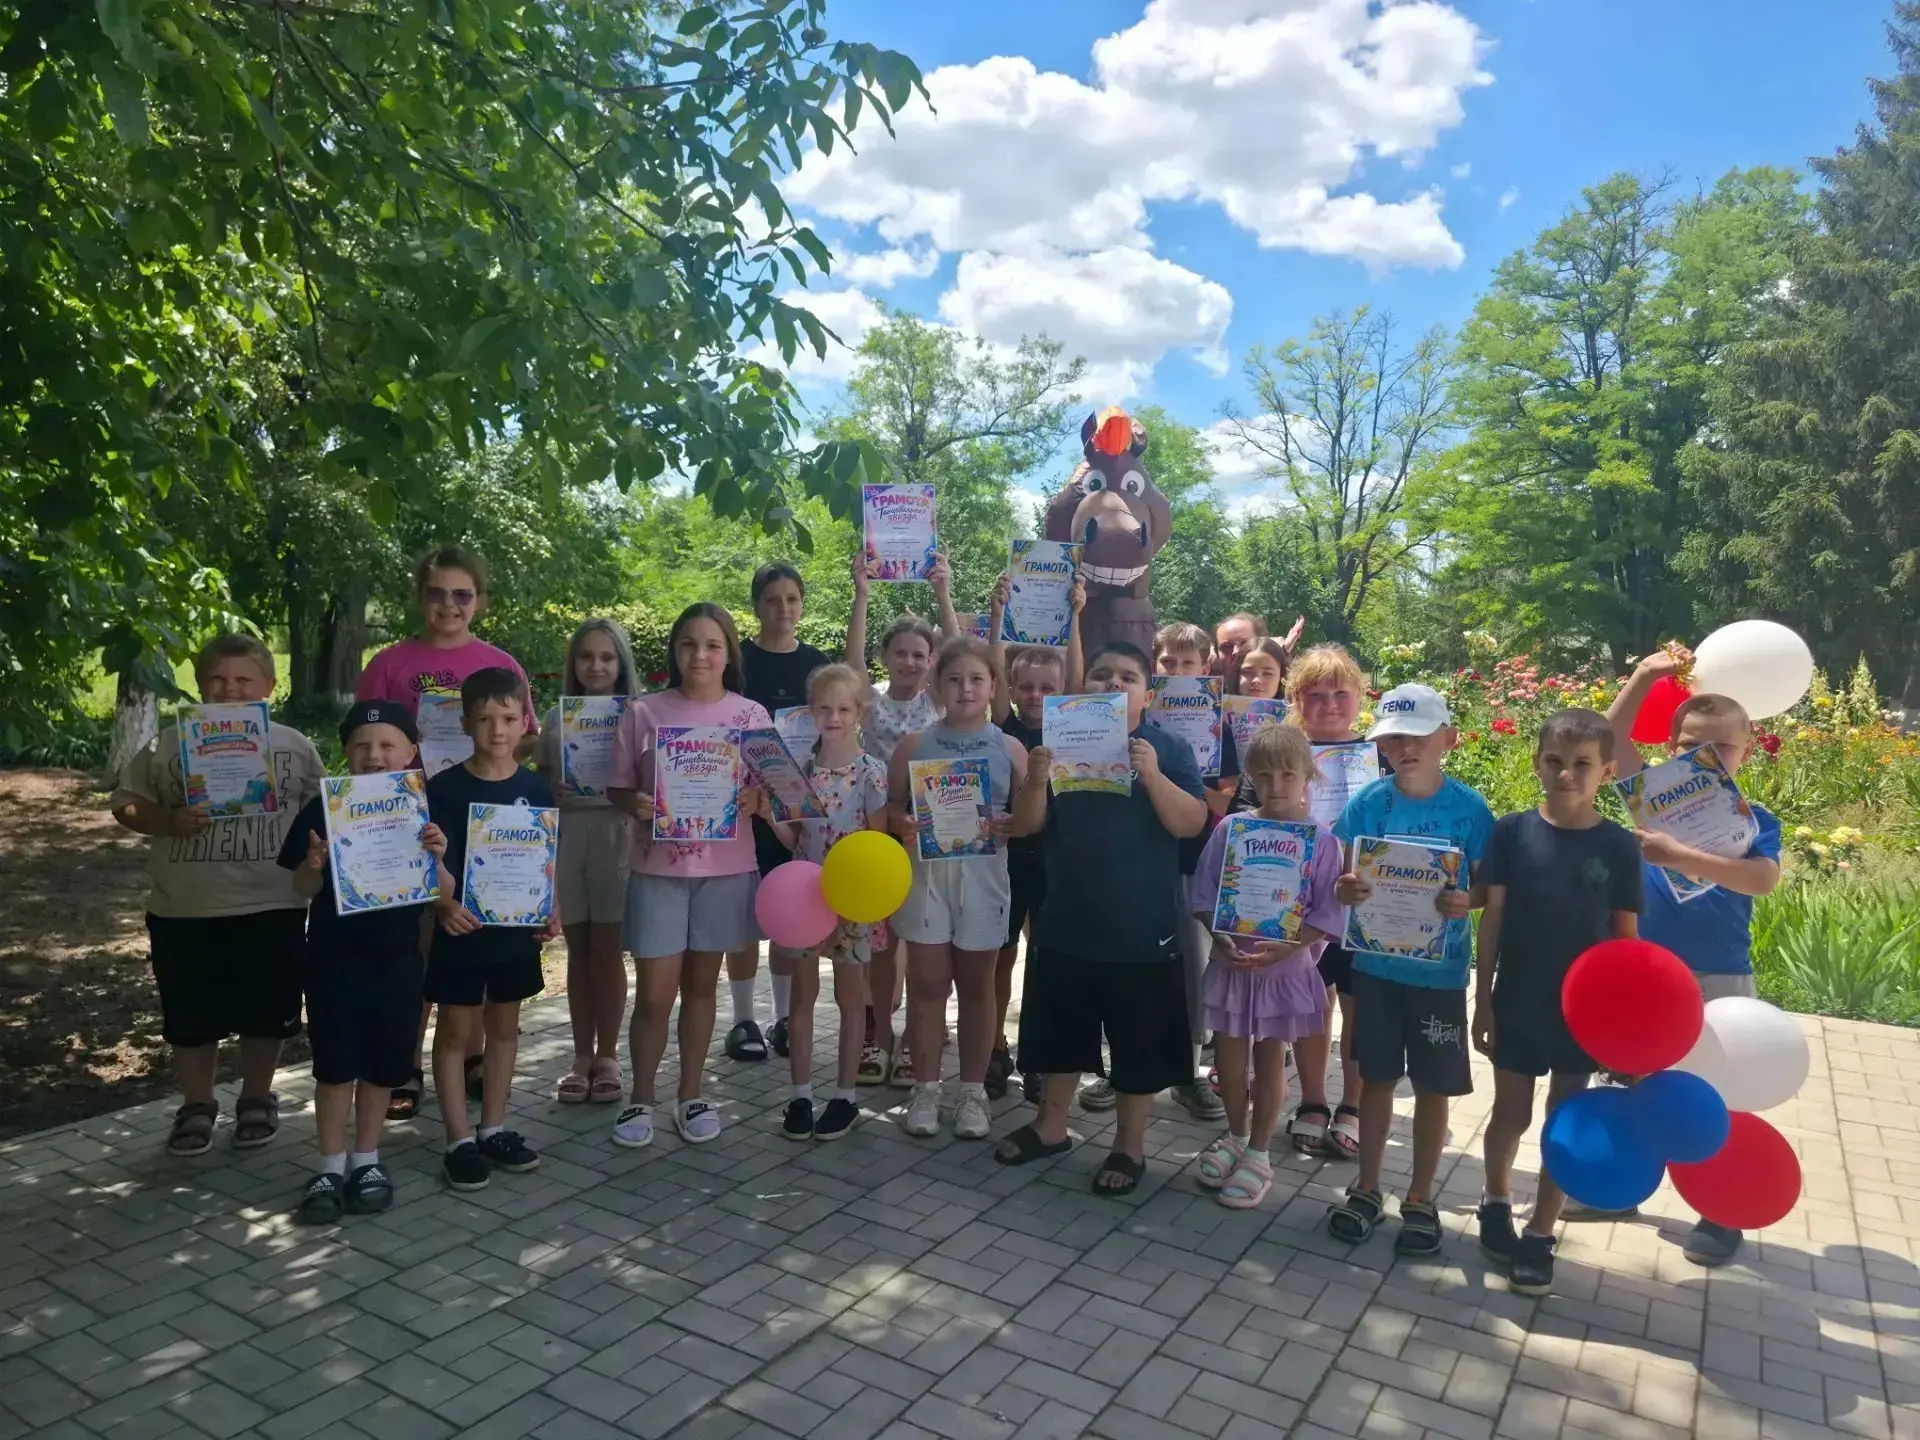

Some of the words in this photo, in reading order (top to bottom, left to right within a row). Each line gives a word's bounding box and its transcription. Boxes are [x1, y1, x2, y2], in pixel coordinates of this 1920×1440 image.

[871, 495, 930, 508] ГРАМОТА
[1024, 561, 1068, 573] ГРАМОТА
[1162, 696, 1208, 708] ГРАМОТА
[1382, 700, 1416, 713] FENDI
[192, 720, 260, 738] ГРАМОТА
[580, 715, 619, 729] ГРАМОТ
[666, 740, 734, 758] ГРАМОТА
[669, 753, 730, 771] Танцевальная
[683, 764, 719, 777] звезда
[924, 775, 981, 790] ГРАМОТА
[1650, 775, 1712, 812] ГРАМОТА
[350, 797, 410, 818] ГРАМОТА
[488, 829, 541, 842] ГРАМОТА
[1243, 838, 1298, 857] ГРАМОТА
[1377, 864, 1439, 882] ГРАМОТА
[688, 1103, 709, 1112] NIKE
